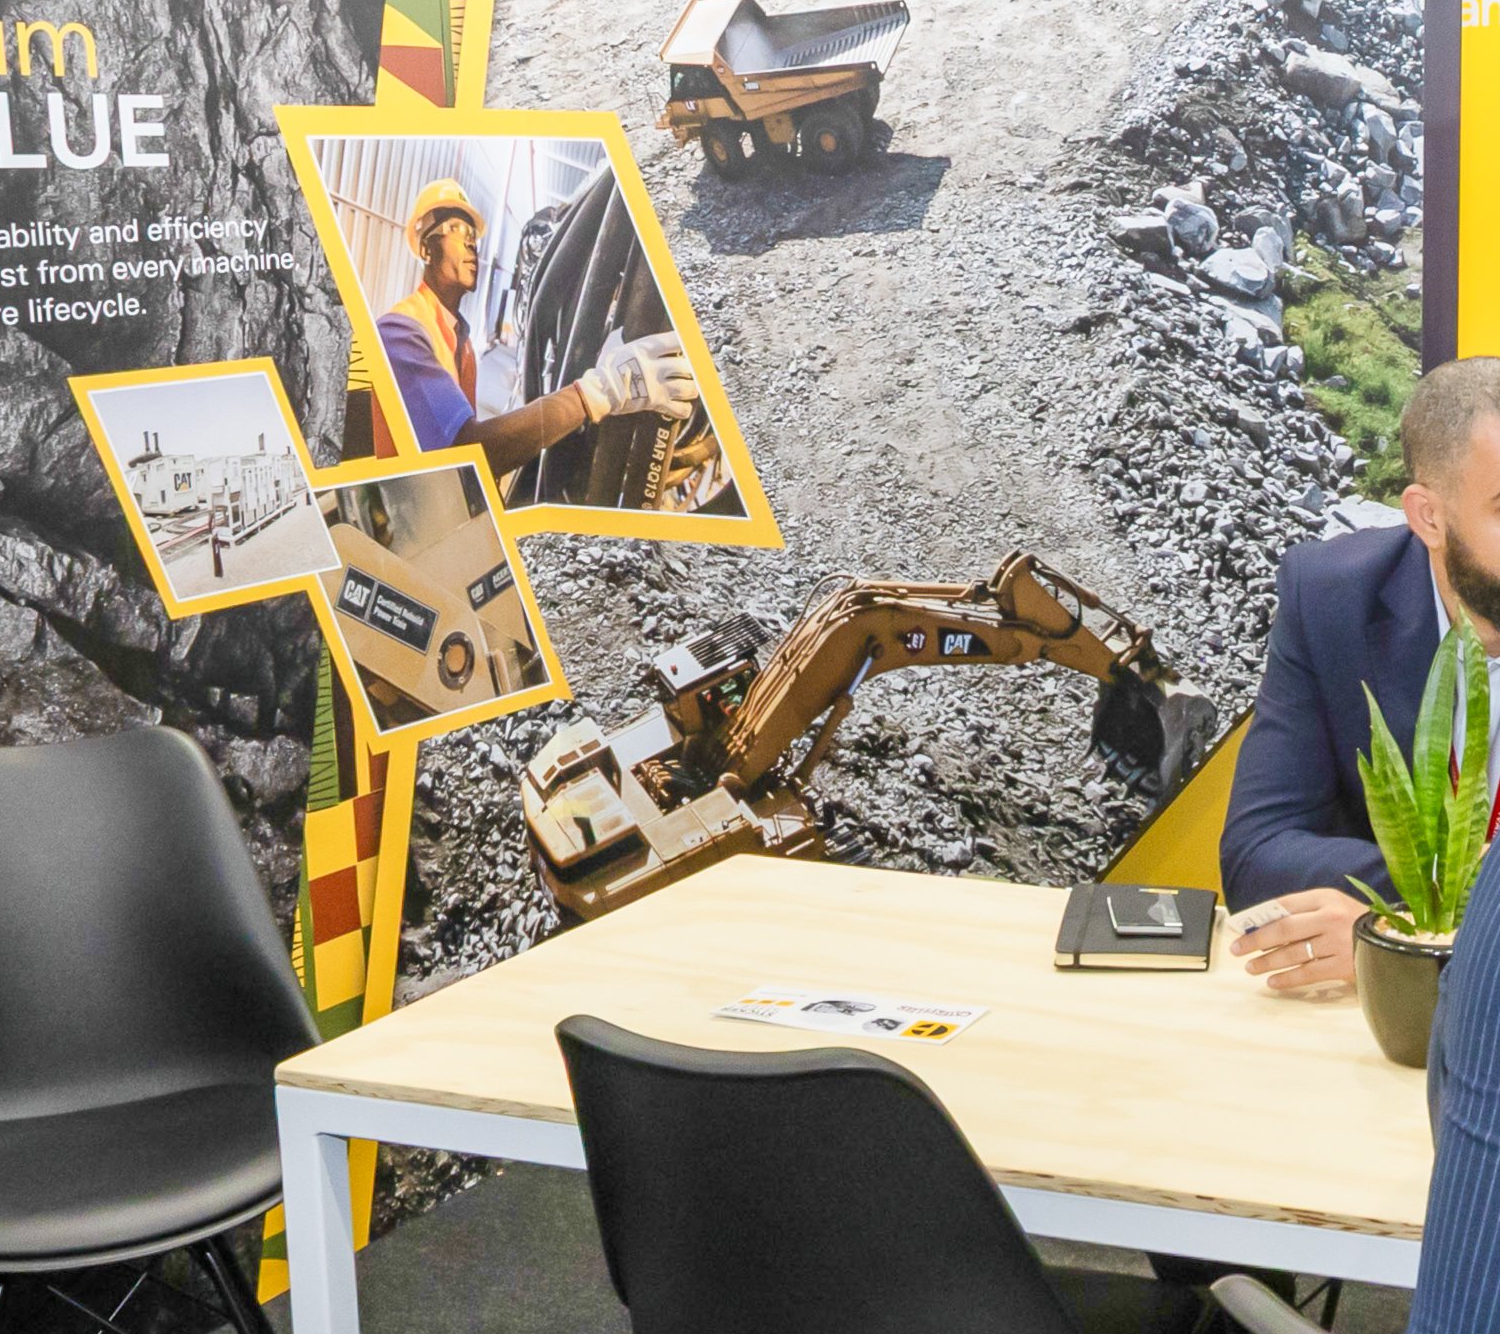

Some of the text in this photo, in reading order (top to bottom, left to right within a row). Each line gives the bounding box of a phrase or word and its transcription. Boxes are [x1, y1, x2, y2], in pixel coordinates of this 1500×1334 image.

[89, 219, 139, 244] and
[147, 215, 268, 243] efficiency
[38, 259, 105, 284] from
[112, 258, 185, 282] every
[191, 251, 300, 274] machine,
[28, 293, 148, 326] lifecycle.
[652, 427, 671, 462] BAR
[173, 472, 192, 491] CAT
[344, 579, 371, 607] CAT
[944, 634, 973, 655] CAT
